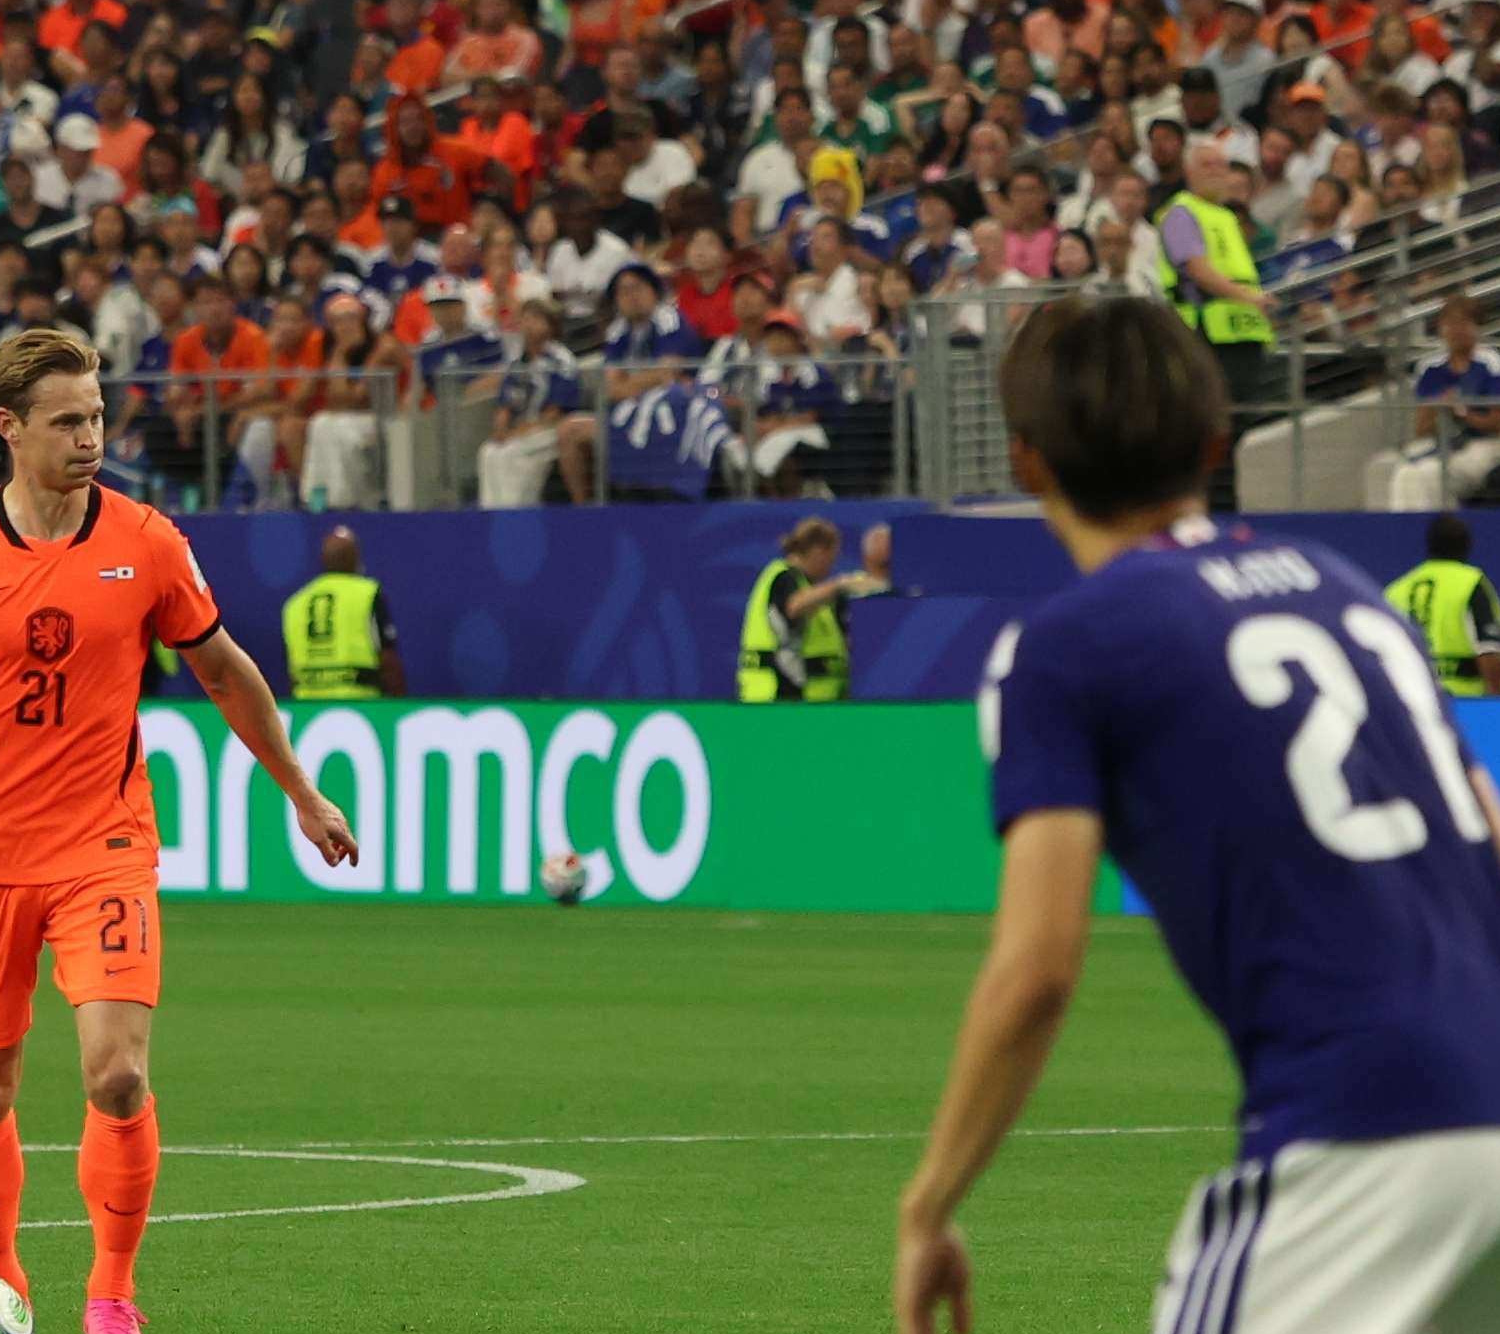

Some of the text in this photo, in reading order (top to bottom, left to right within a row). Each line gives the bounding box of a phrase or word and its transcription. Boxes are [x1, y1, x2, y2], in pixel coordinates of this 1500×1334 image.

[14, 669, 66, 728] 21
[1226, 603, 1492, 862] 21
[139, 706, 712, 901] aramco
[99, 896, 147, 955] 21
